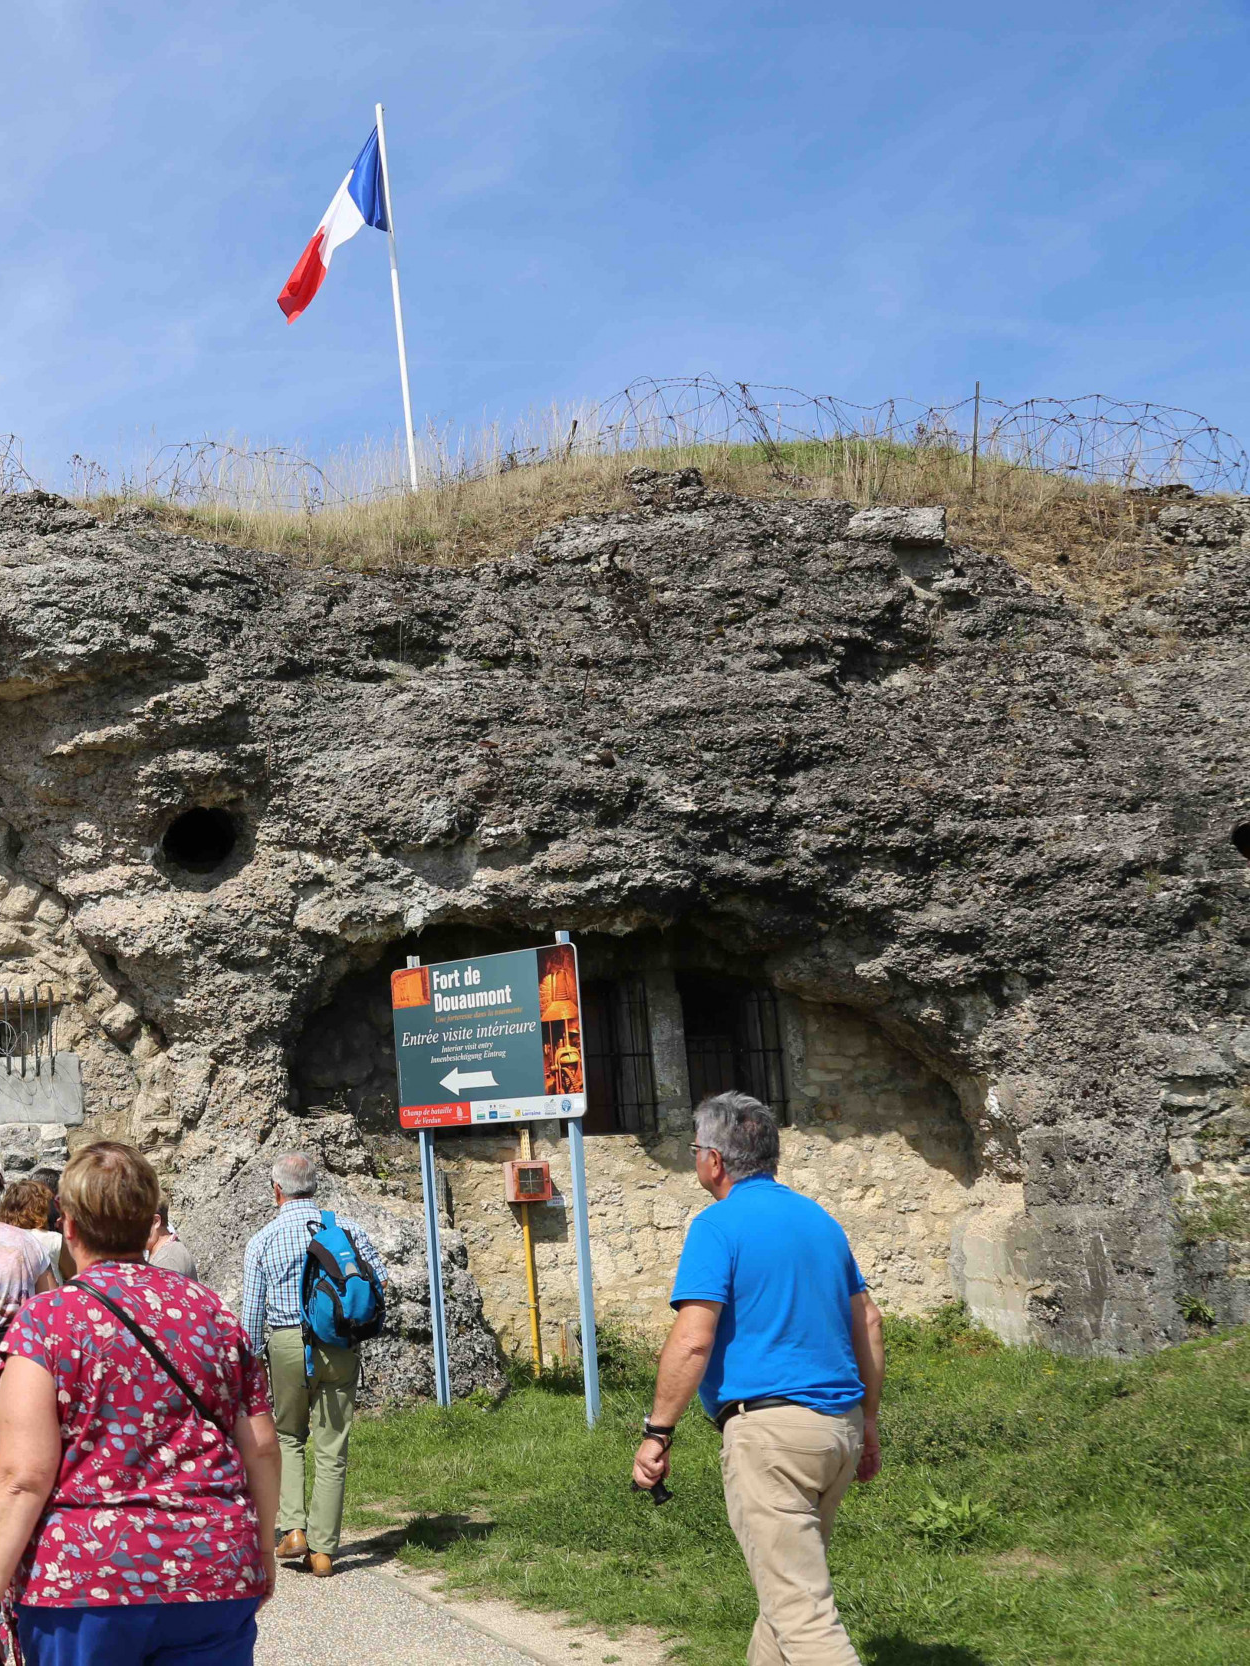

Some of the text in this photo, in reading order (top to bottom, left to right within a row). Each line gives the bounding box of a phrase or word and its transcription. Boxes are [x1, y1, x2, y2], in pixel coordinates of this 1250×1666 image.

[432, 966, 480, 990] Fort de
[434, 985, 512, 1012] Douaumont
[402, 1020, 536, 1046] Entrée visite intérieure
[430, 1050, 506, 1064] Innenbesichtigung Eintrag
[442, 1044, 463, 1053] Interior
[431, 1106, 452, 1114] bataille
